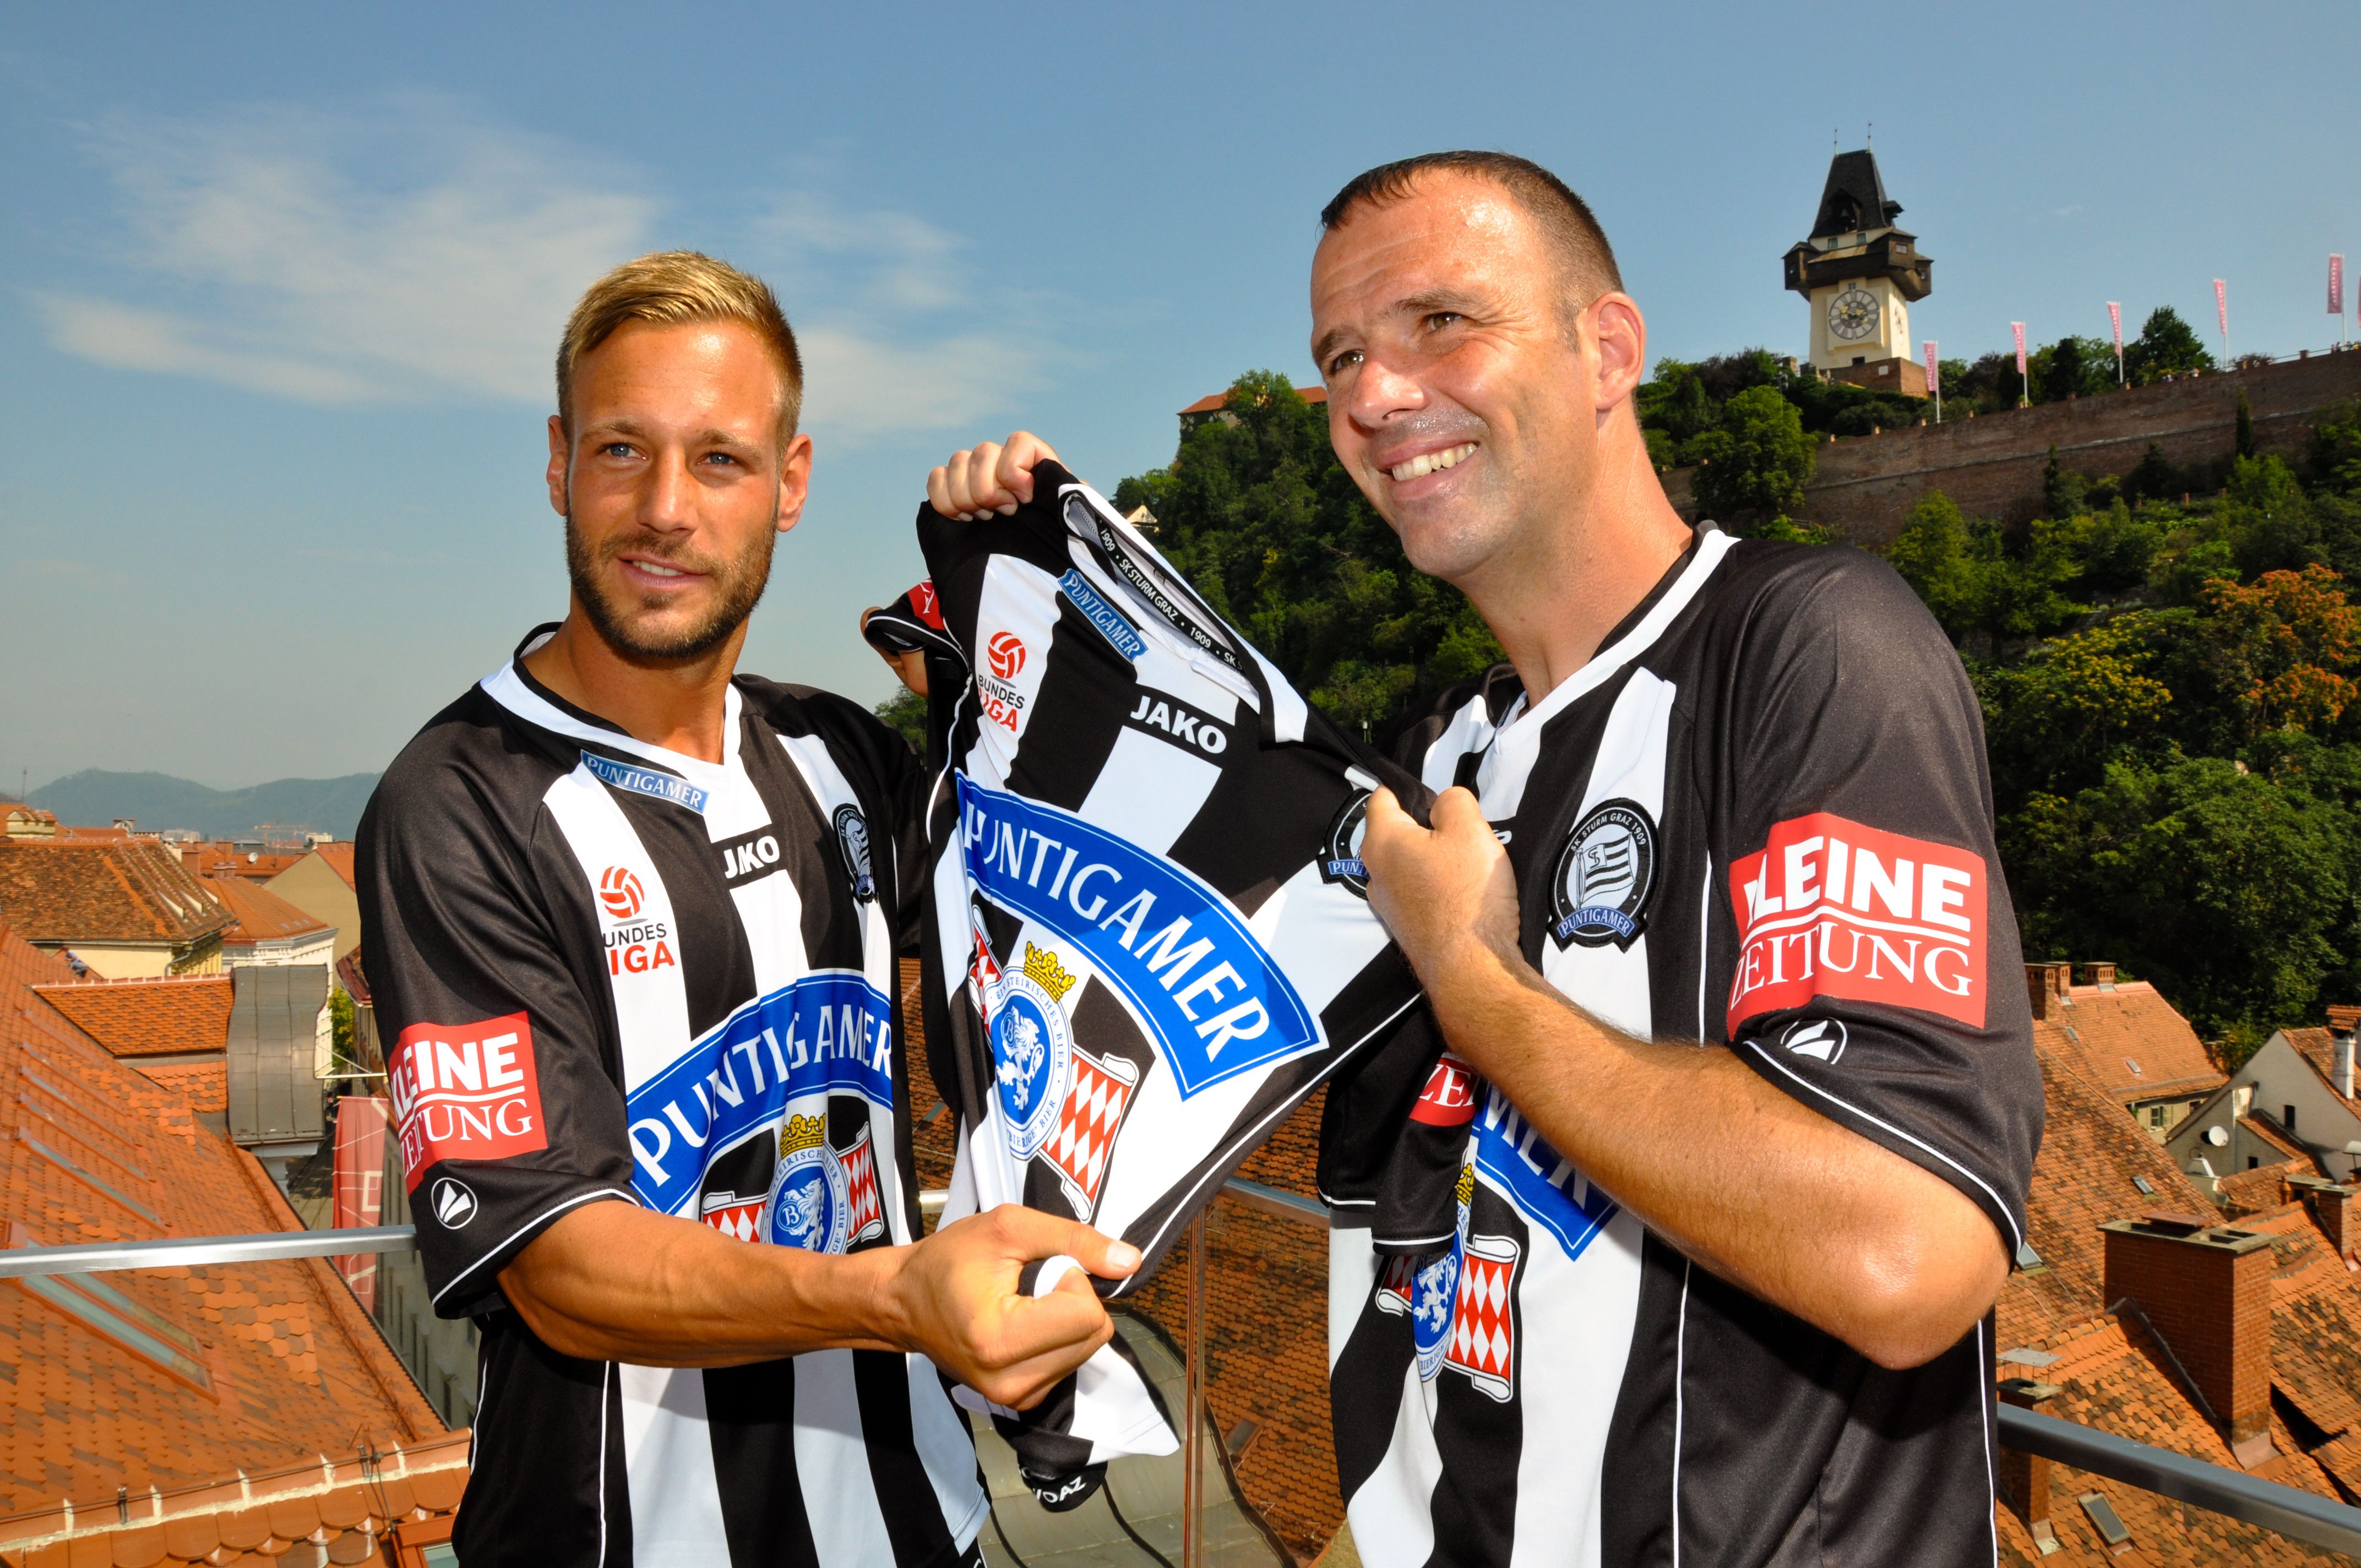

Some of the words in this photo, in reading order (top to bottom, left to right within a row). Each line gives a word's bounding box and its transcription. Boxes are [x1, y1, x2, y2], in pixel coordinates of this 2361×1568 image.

[1064, 573, 1140, 656] PUNTIGAMER
[1101, 528, 1116, 552] 1909
[1119, 558, 1133, 574] SK
[1128, 569, 1157, 601] STURM
[1155, 596, 1179, 622] GRAZ
[1190, 627, 1212, 649] 1909
[1224, 652, 1237, 667] SK
[978, 674, 1025, 709] BUNDES
[1130, 695, 1227, 754] JAKO
[587, 756, 702, 808] PUNTIGAMER
[1571, 839, 1581, 852] SK
[1581, 814, 1608, 838] STURM
[1609, 812, 1633, 826] GRAZ
[1630, 822, 1647, 845] 1909
[603, 923, 667, 948] UNDES
[964, 799, 1270, 1064] PUNTIGAMER
[1561, 908, 1631, 935] PUNTIGAMER
[609, 940, 676, 976] IGA
[1730, 921, 1973, 1011] ZEITUNG
[1007, 976, 1059, 1027] STEIRISCHES
[1056, 1032, 1064, 1069] BIER
[628, 1004, 893, 1189] PUNTIGAMER
[1039, 1099, 1057, 1129] BIER
[400, 1098, 532, 1177] ZEITUNG
